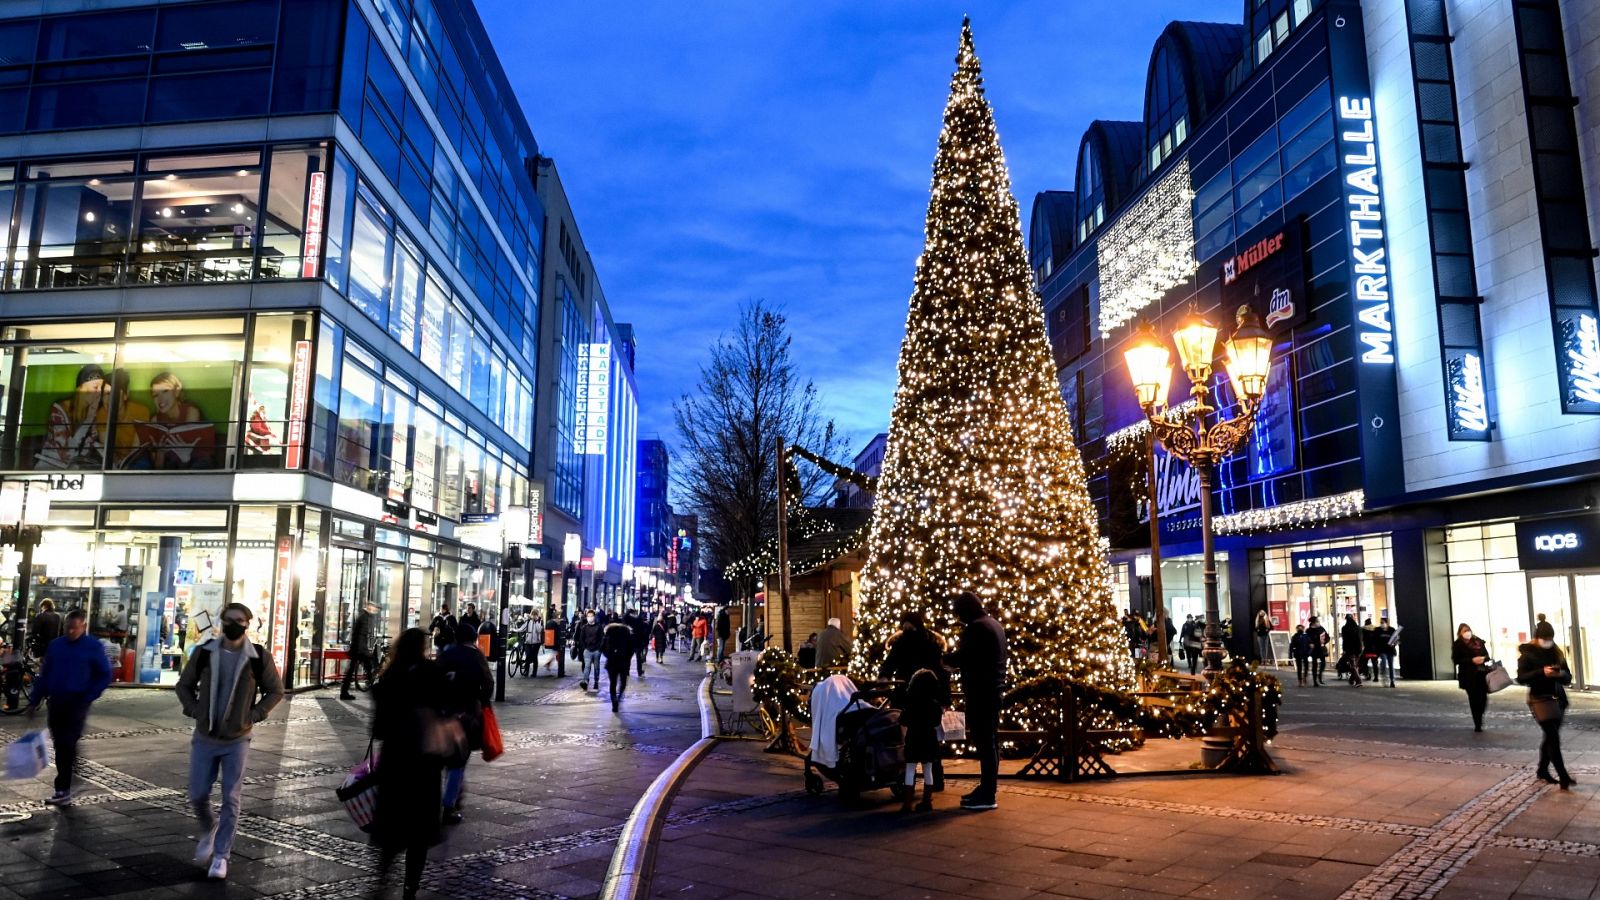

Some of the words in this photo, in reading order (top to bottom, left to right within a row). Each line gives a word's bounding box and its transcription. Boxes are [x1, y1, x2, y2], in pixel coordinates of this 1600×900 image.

[1340, 96, 1394, 364] MARKTHALLE
[1237, 232, 1284, 274] Müller
[1271, 289, 1290, 313] dm
[596, 346, 607, 452] KARSTADT
[529, 490, 540, 541] Hugendubel
[1298, 555, 1352, 569] ETERNA
[1535, 533, 1578, 551] IQOS
